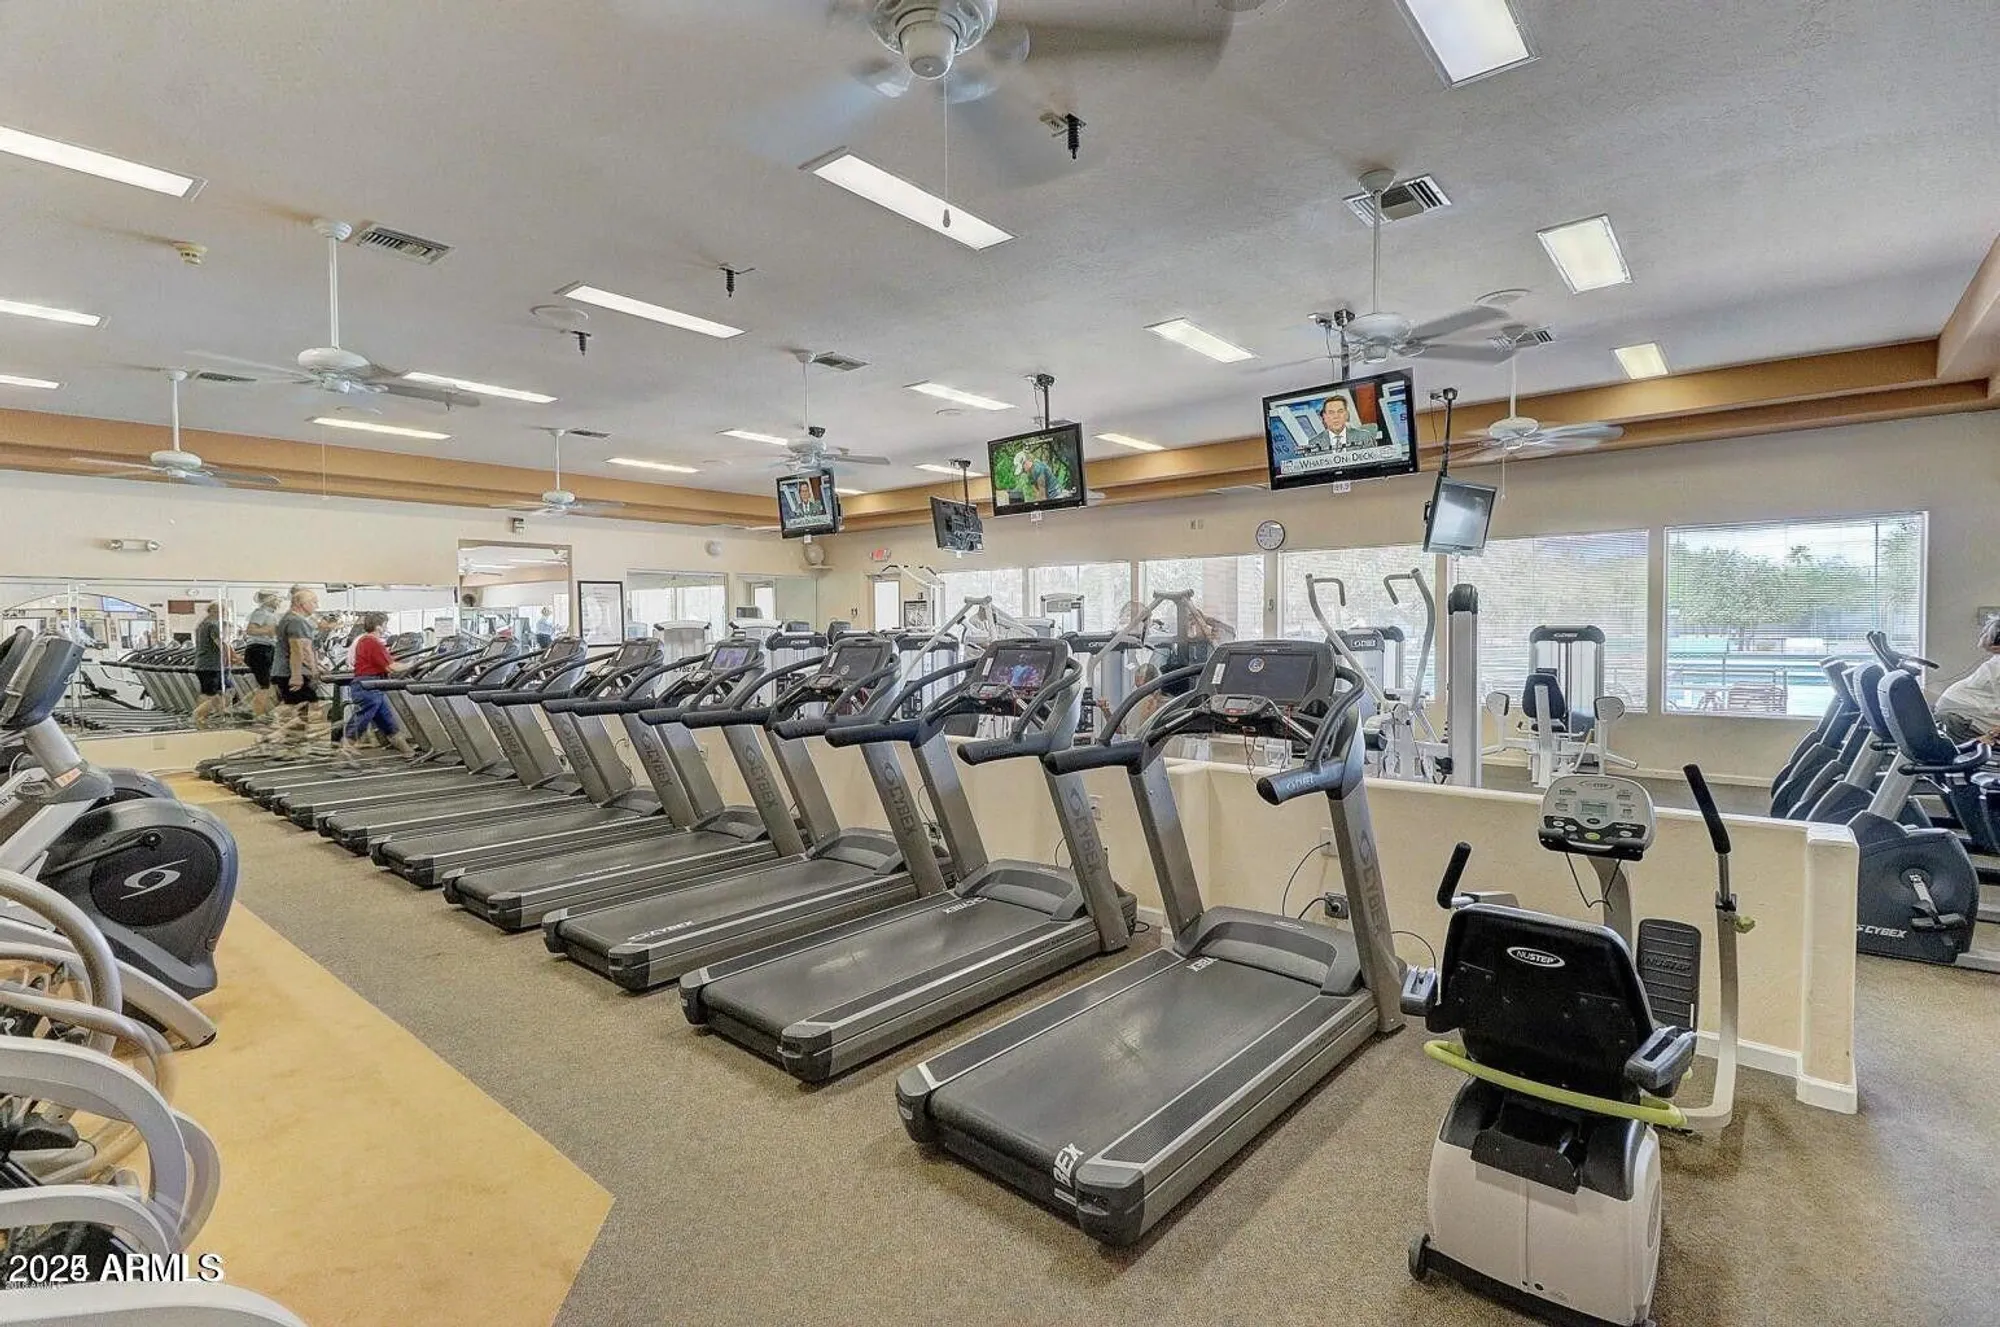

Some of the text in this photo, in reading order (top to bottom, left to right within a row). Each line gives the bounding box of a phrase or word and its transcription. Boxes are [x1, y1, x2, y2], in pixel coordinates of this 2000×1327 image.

[888, 784, 917, 835] CYBEX
[1864, 925, 1908, 939] CYBEX
[1516, 949, 1555, 965] NUSTEP
